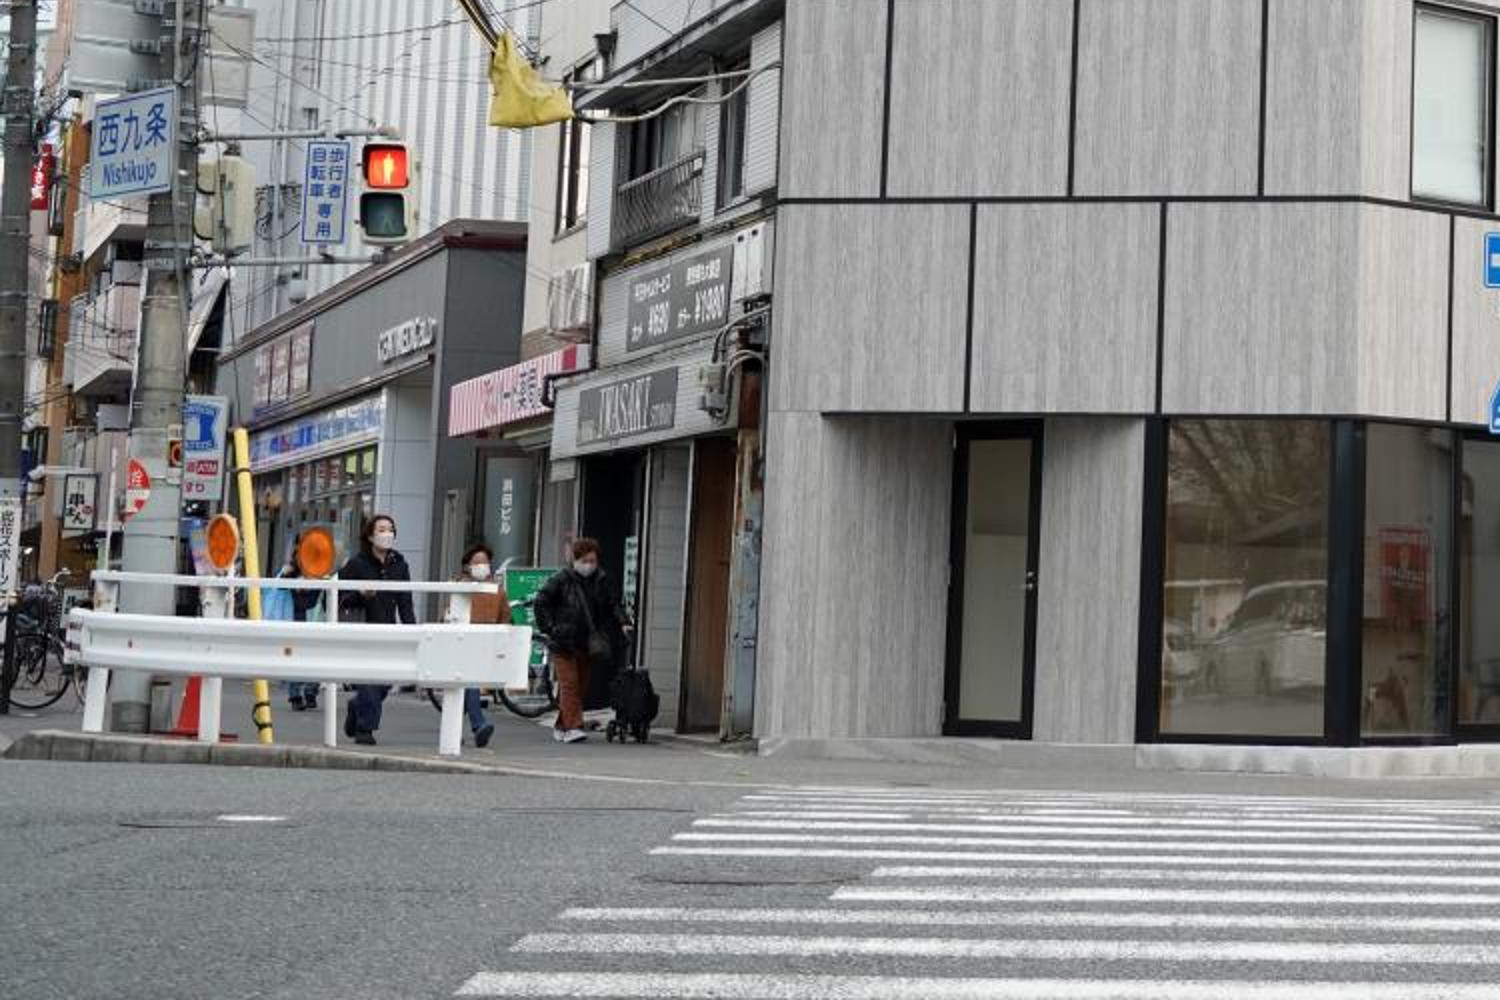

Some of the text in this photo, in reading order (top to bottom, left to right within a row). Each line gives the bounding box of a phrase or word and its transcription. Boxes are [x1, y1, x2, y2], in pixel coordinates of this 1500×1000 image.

[98, 103, 168, 156] 西九条
[102, 160, 157, 188] Nishikujo
[329, 148, 344, 198] 歩行者
